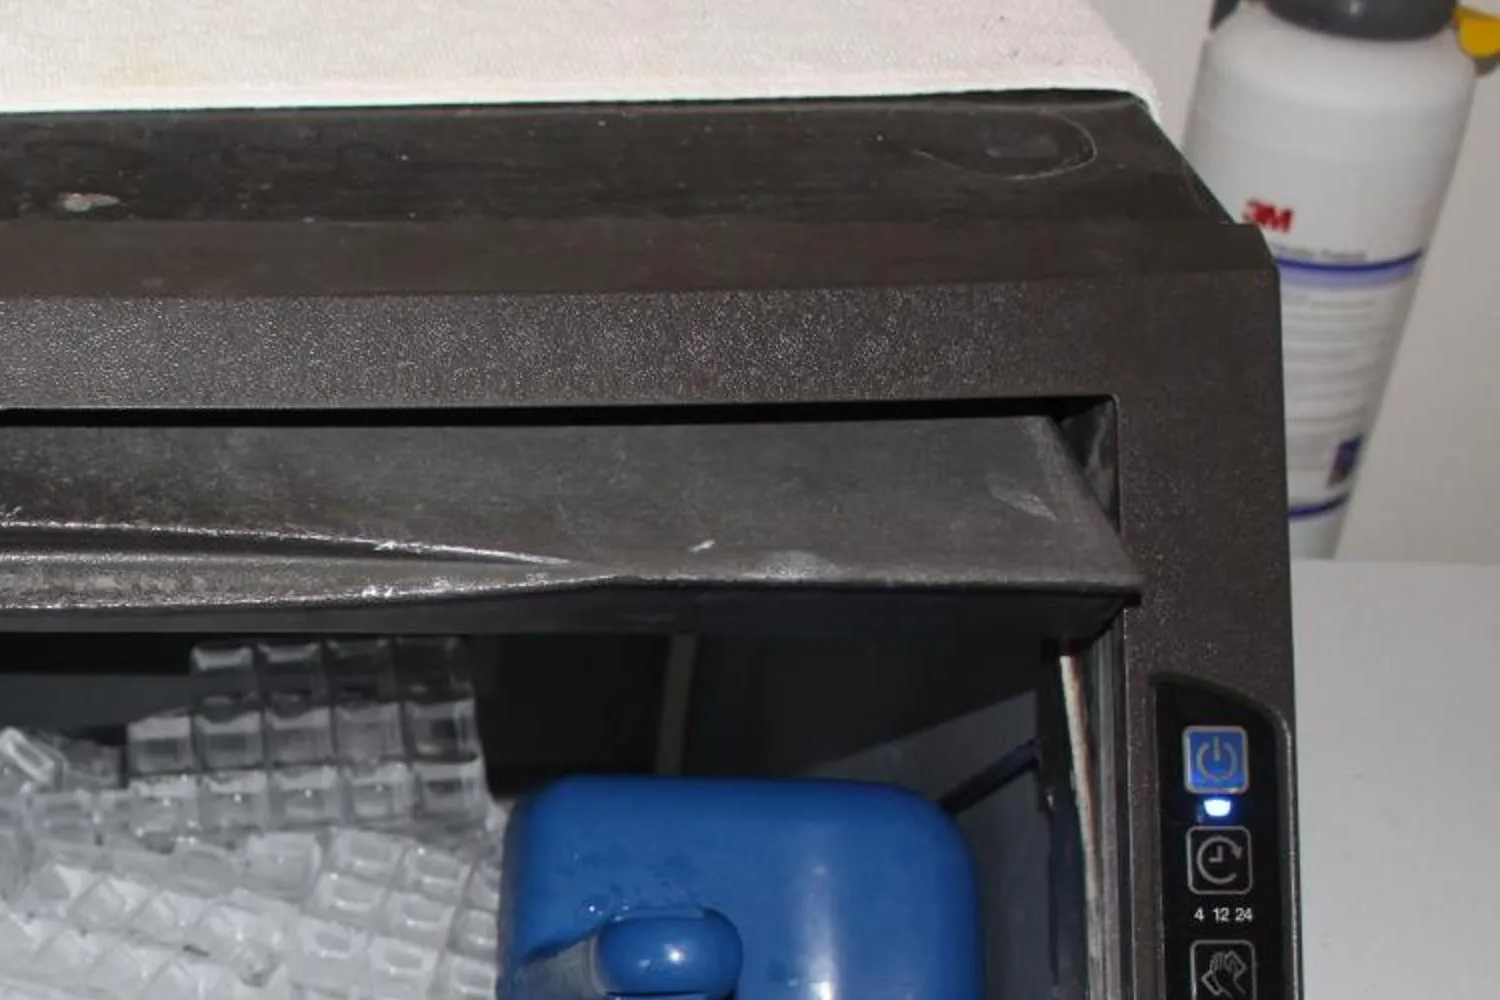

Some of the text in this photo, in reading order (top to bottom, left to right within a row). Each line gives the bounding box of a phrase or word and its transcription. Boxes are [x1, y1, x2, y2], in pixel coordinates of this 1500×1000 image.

[1243, 199, 1293, 233] 3M
[1194, 906, 1253, 922] 4 12 24
